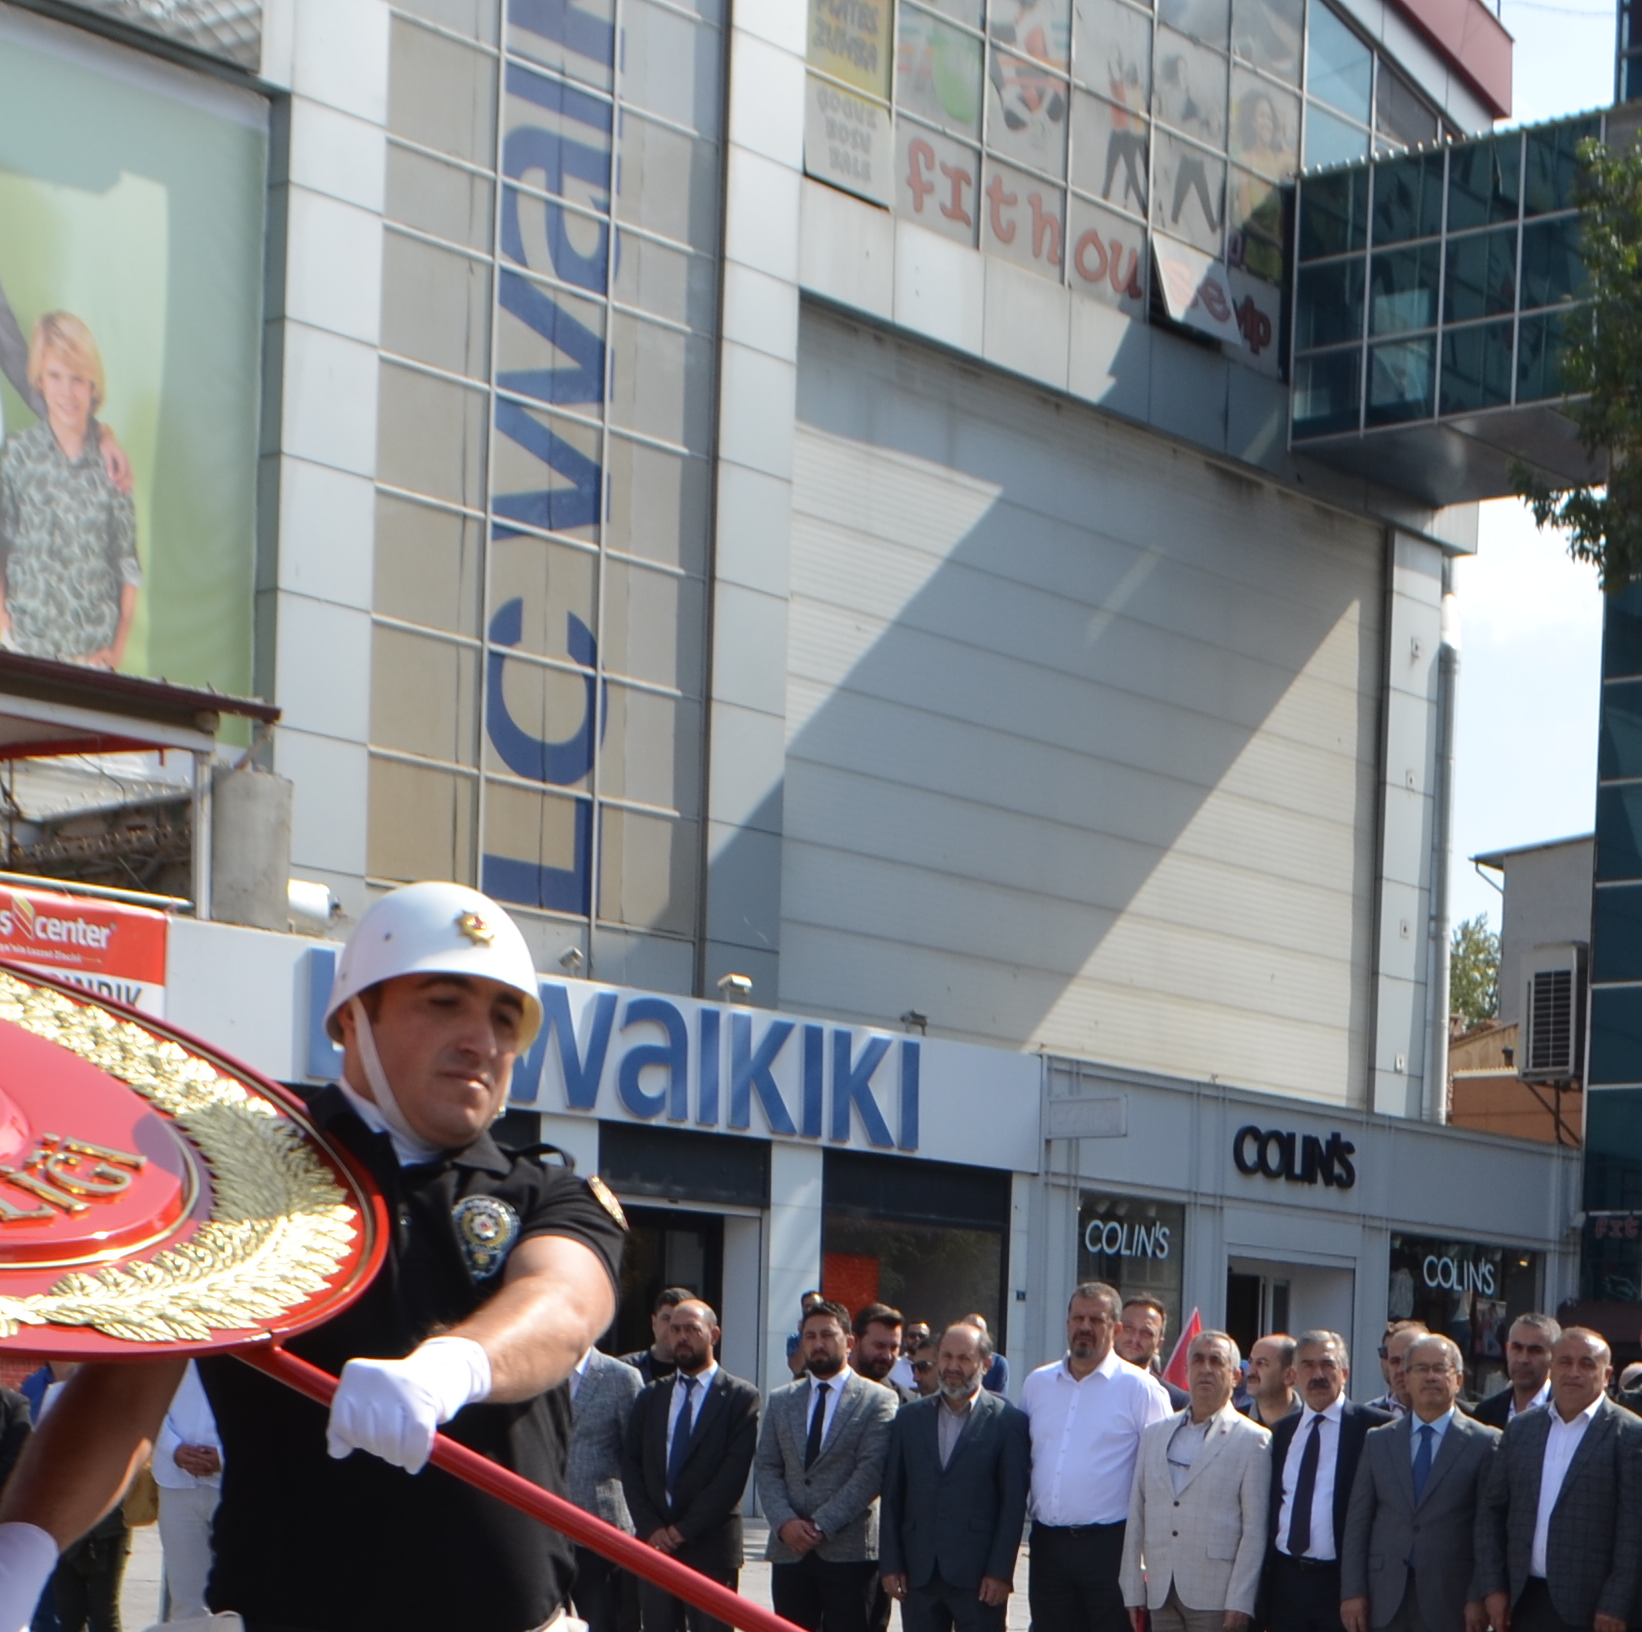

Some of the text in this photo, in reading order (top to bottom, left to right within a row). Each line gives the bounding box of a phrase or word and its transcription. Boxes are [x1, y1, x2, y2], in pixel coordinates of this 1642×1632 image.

[480, 597, 609, 918] LC
[35, 914, 111, 948] center
[1233, 1124, 1356, 1190] COLIN'S
[1085, 1218, 1171, 1259] COLIN'S
[1423, 1254, 1496, 1296] COLIN'S
